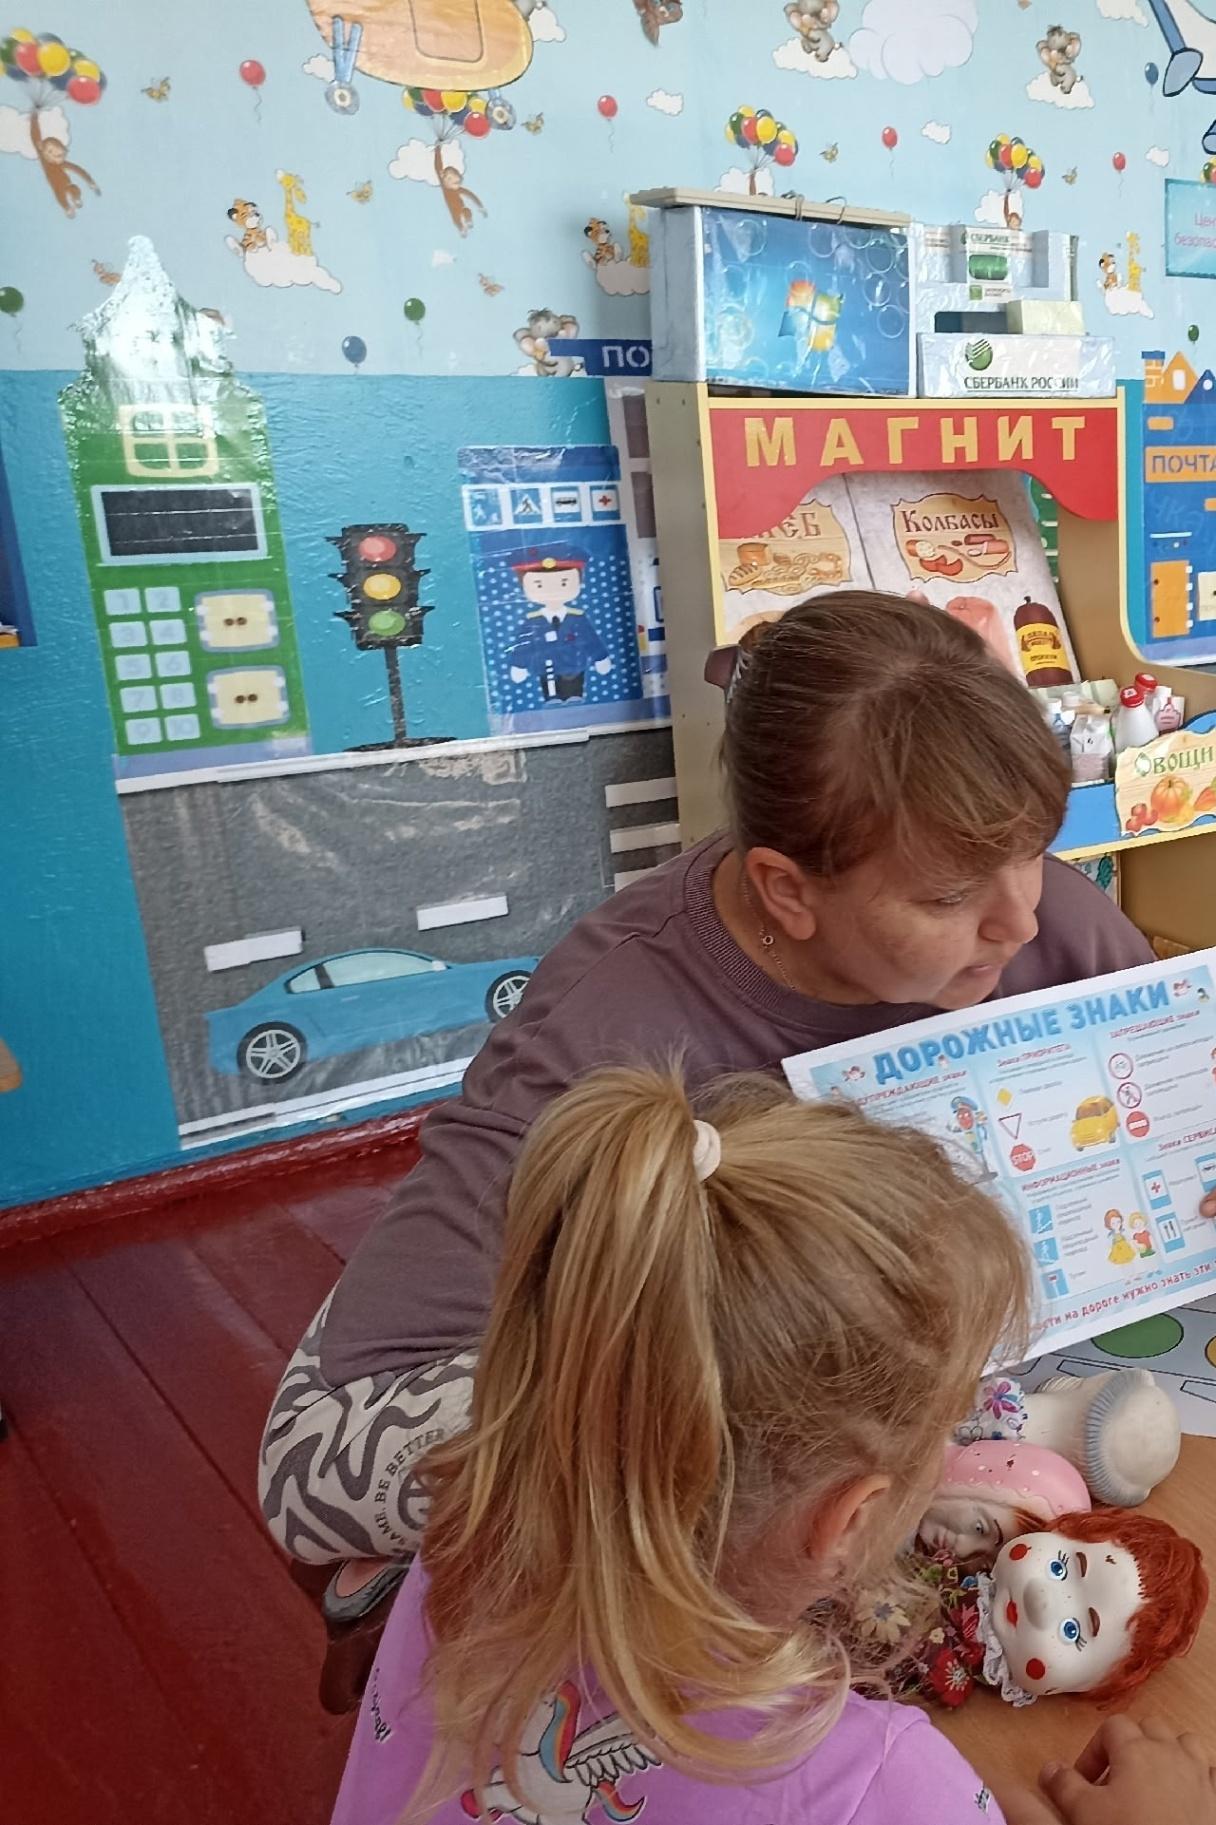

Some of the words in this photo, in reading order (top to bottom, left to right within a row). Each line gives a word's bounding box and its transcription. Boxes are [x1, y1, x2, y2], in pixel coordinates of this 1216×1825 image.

[963, 376, 1028, 390] СБЕРБАНК
[744, 415, 1086, 468] МАГНИТ
[872, 1008, 1063, 1086] ДОРОЖНЫЕ
[1069, 980, 1171, 1031] ЗНАКИ
[1081, 1296, 1120, 1317] дороге
[1122, 1281, 1160, 1303] нужно
[1161, 1270, 1191, 1288] знать
